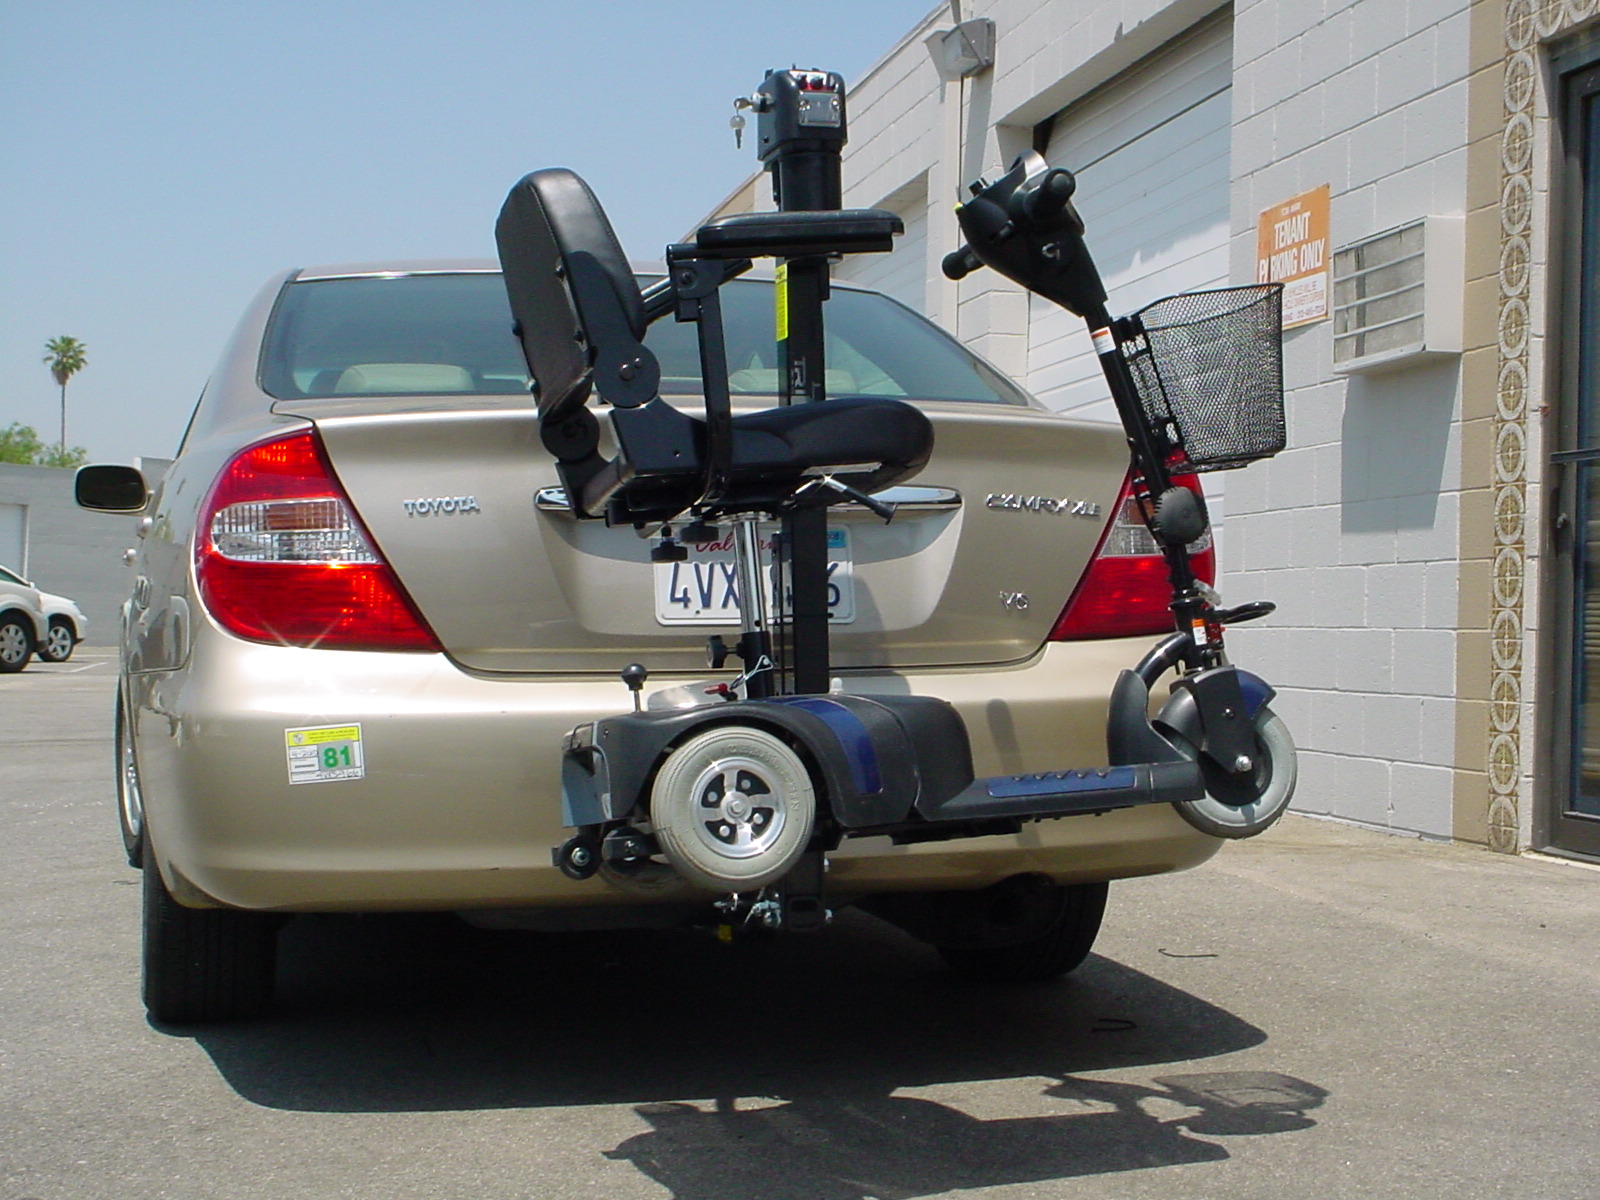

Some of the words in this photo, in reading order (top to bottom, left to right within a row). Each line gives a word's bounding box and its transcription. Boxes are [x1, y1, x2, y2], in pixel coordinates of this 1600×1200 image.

[1274, 212, 1311, 249] TENANT
[1300, 238, 1325, 272] ONLY
[403, 496, 481, 515] TOYOTA
[986, 493, 1068, 514] CAMRY
[999, 590, 1029, 610] V6
[323, 745, 352, 768] 81
